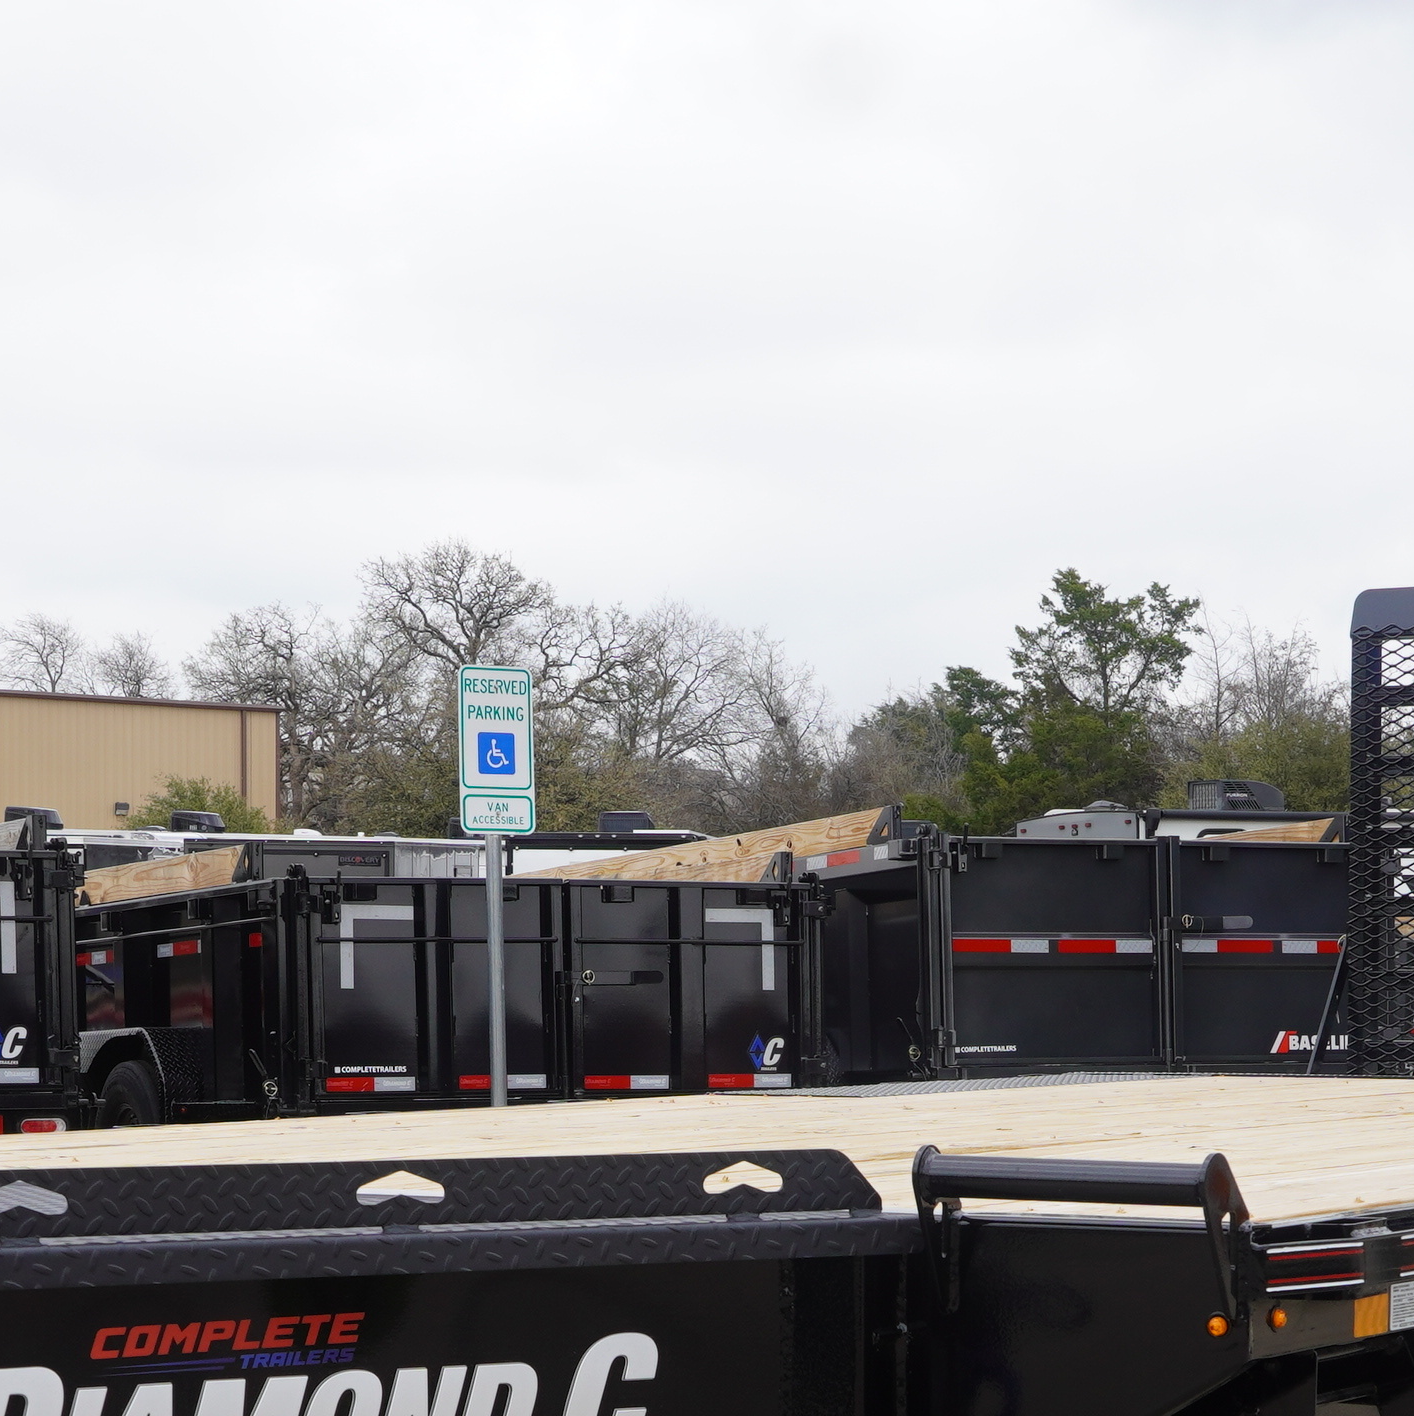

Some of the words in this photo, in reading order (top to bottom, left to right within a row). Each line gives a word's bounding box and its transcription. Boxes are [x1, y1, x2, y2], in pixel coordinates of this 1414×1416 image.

[464, 678, 527, 695] RESERVED
[467, 704, 524, 722] PARKING
[487, 802, 509, 812] VAN
[472, 815, 525, 825] ACCESSIBLE
[341, 1065, 407, 1074] COMPLETETRAILERS
[90, 1312, 366, 1361] COMPLETE
[239, 1347, 356, 1370] TRAILERS
